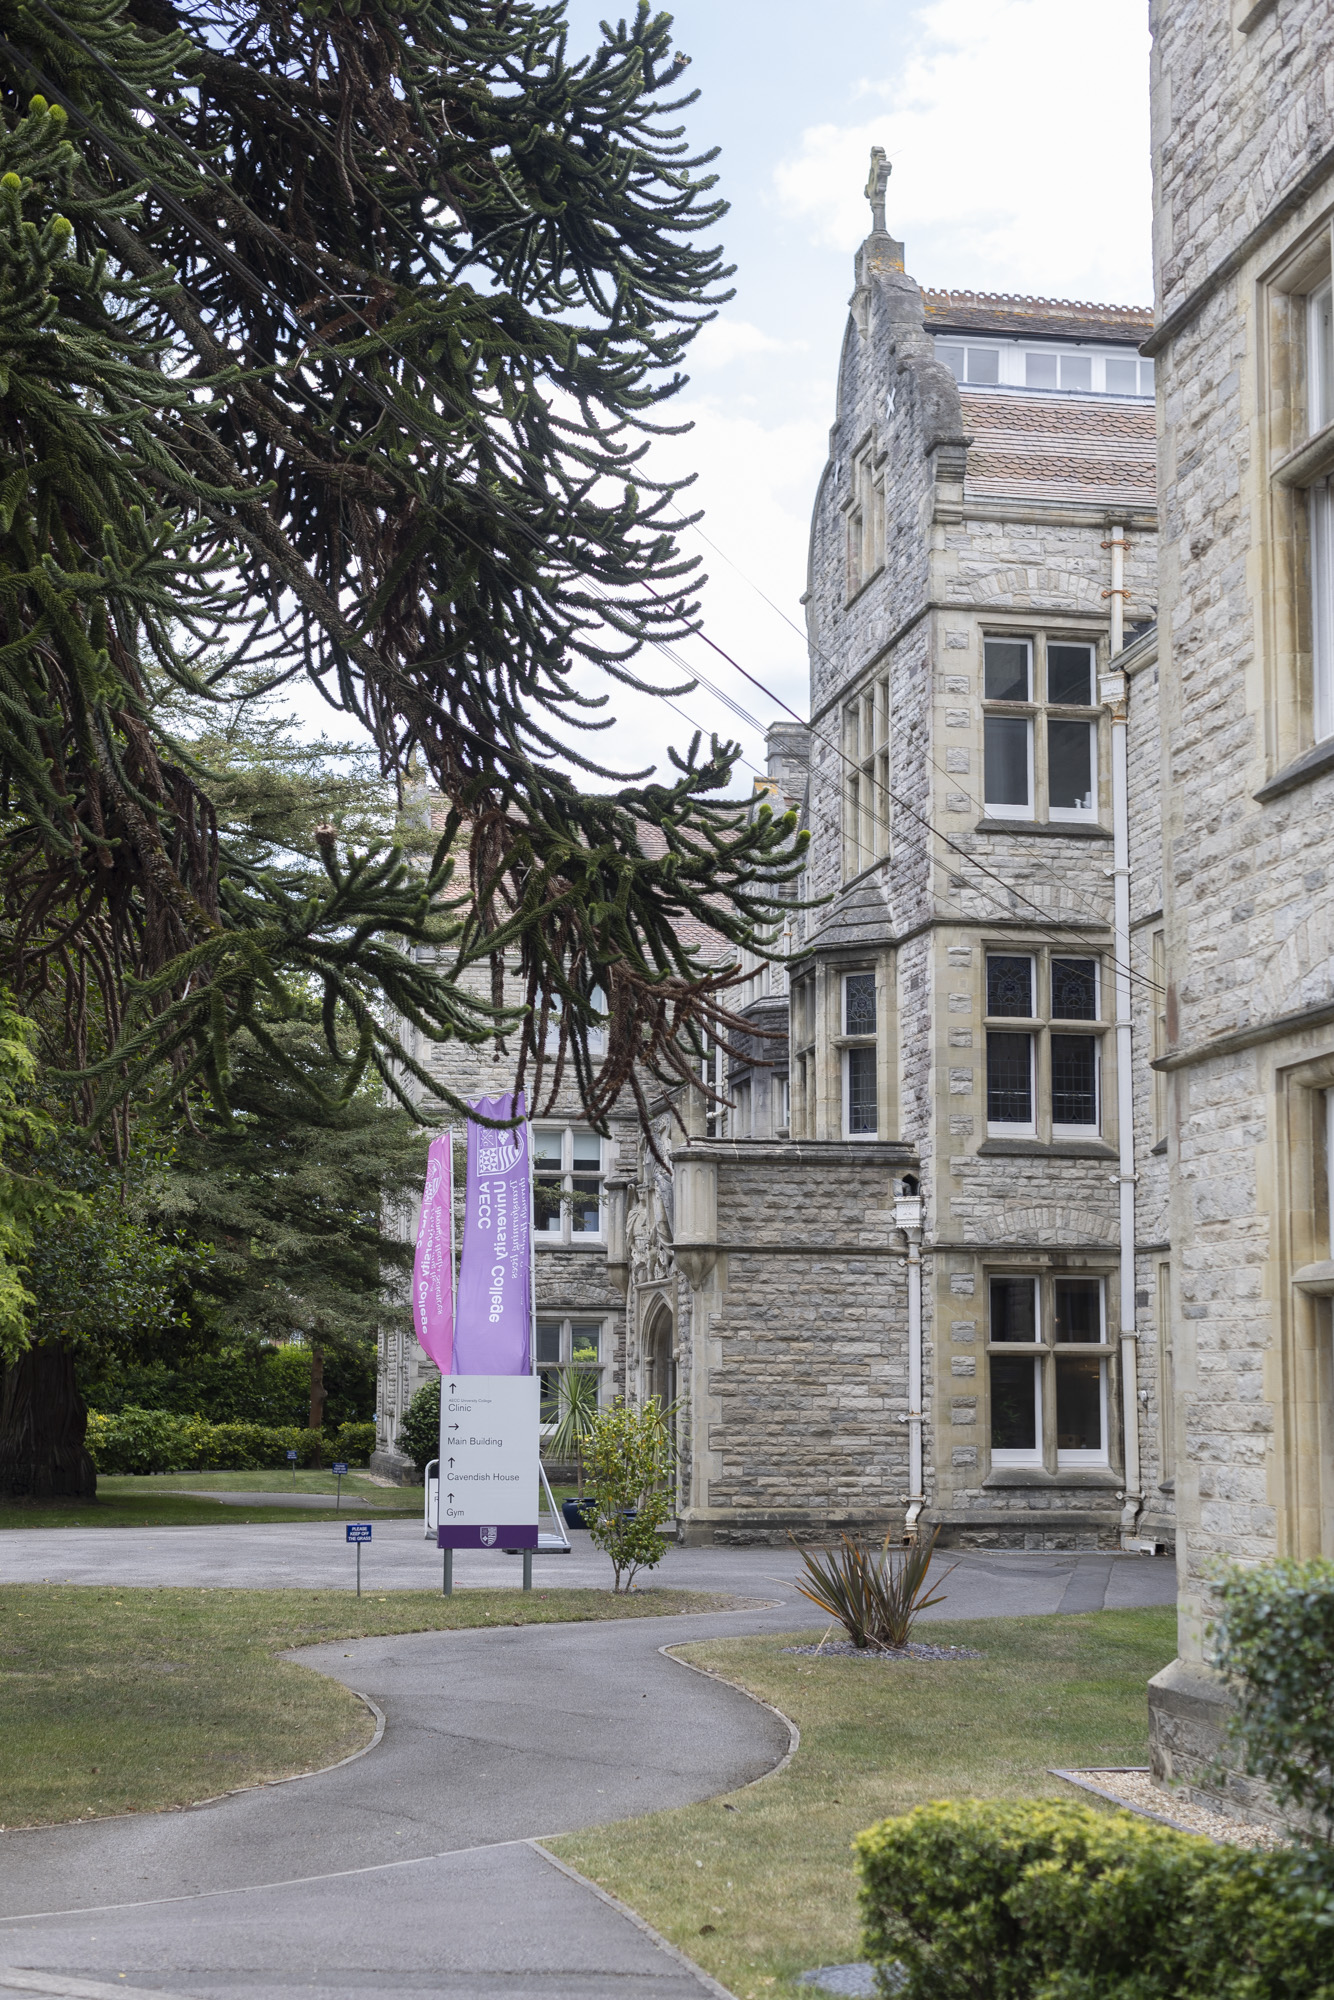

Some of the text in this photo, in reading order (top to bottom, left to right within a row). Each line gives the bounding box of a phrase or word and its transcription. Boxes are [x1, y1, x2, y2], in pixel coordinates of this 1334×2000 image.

[448, 1404, 472, 1412] Clinic
[470, 1437, 503, 1447] Building
[446, 1508, 464, 1518] Gym
